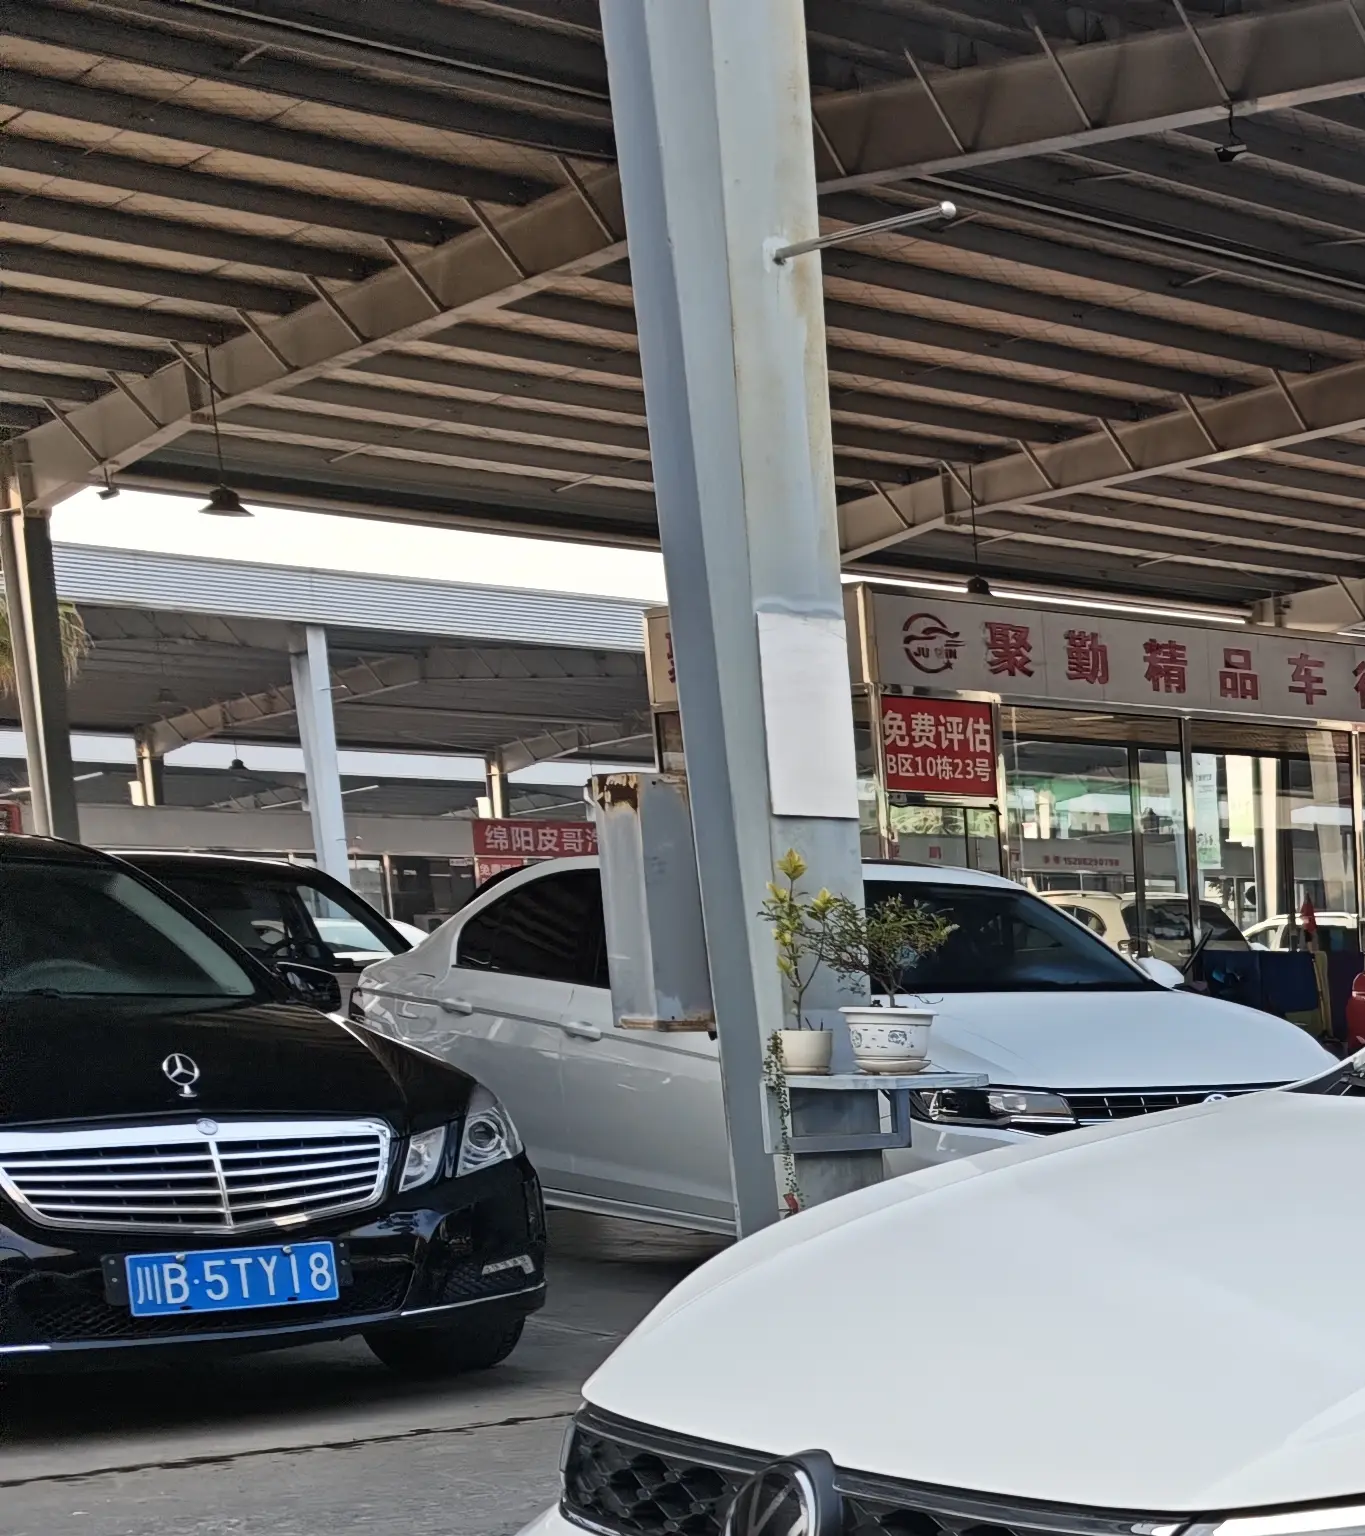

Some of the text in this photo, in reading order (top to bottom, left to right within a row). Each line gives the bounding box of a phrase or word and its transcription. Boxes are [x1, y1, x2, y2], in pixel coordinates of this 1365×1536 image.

[883, 710, 991, 753] 免费评估
[886, 753, 992, 782] B区10栋23号
